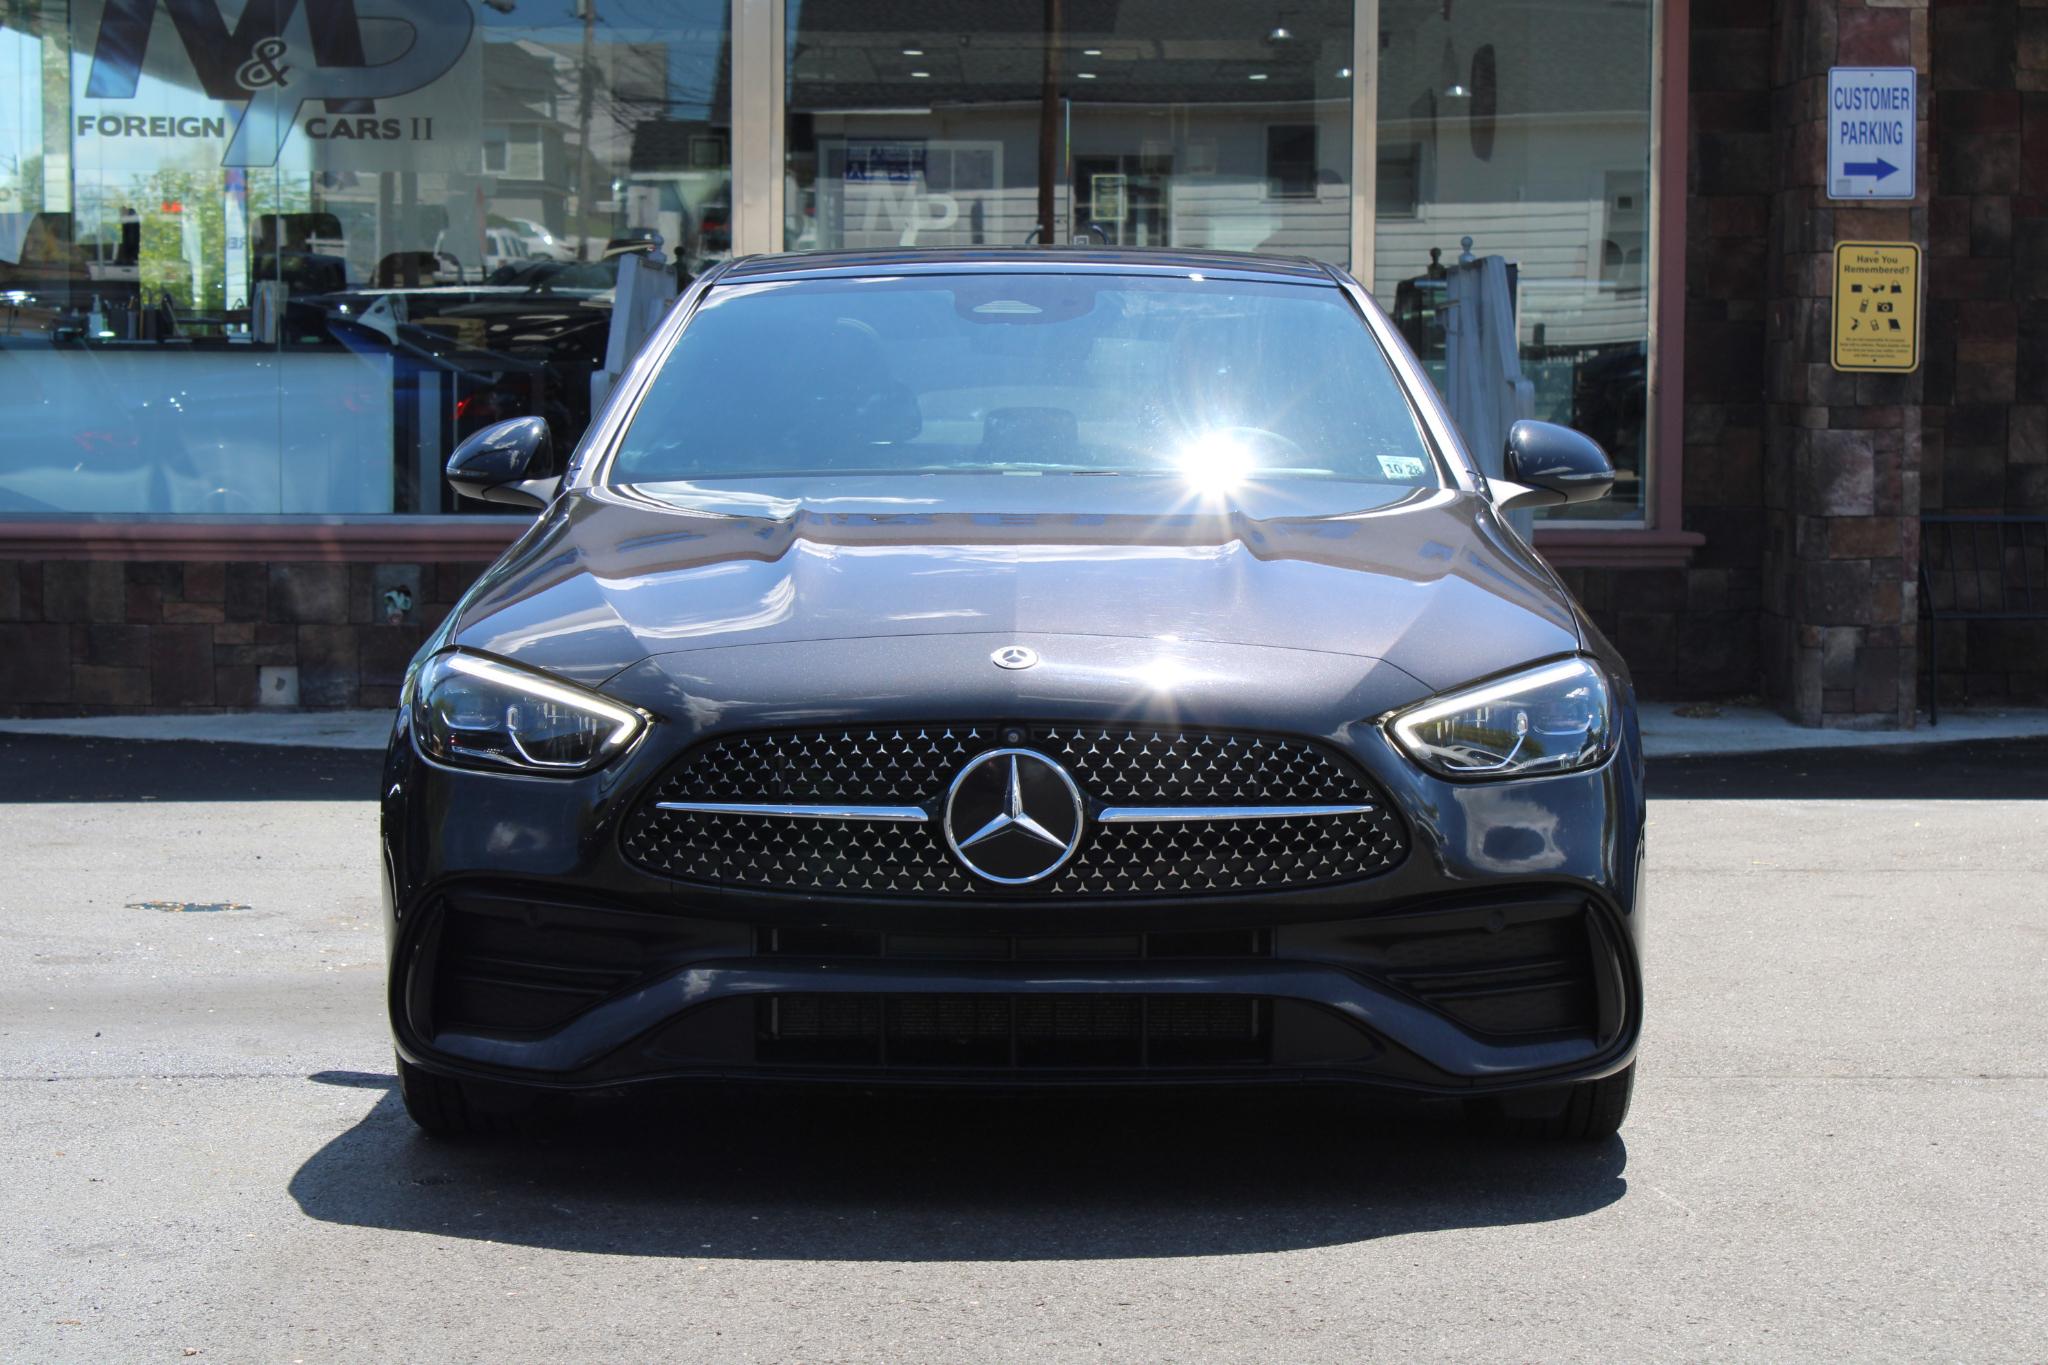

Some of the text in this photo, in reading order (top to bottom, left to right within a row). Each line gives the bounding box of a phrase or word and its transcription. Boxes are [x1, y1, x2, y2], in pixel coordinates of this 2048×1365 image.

[1834, 87, 1910, 111] CUSTOMER
[77, 115, 434, 141] FOREIGN CARS II
[1840, 121, 1904, 145] PARKING
[1844, 264, 1910, 274] Remembered?
[1856, 255, 1898, 264] Have You
